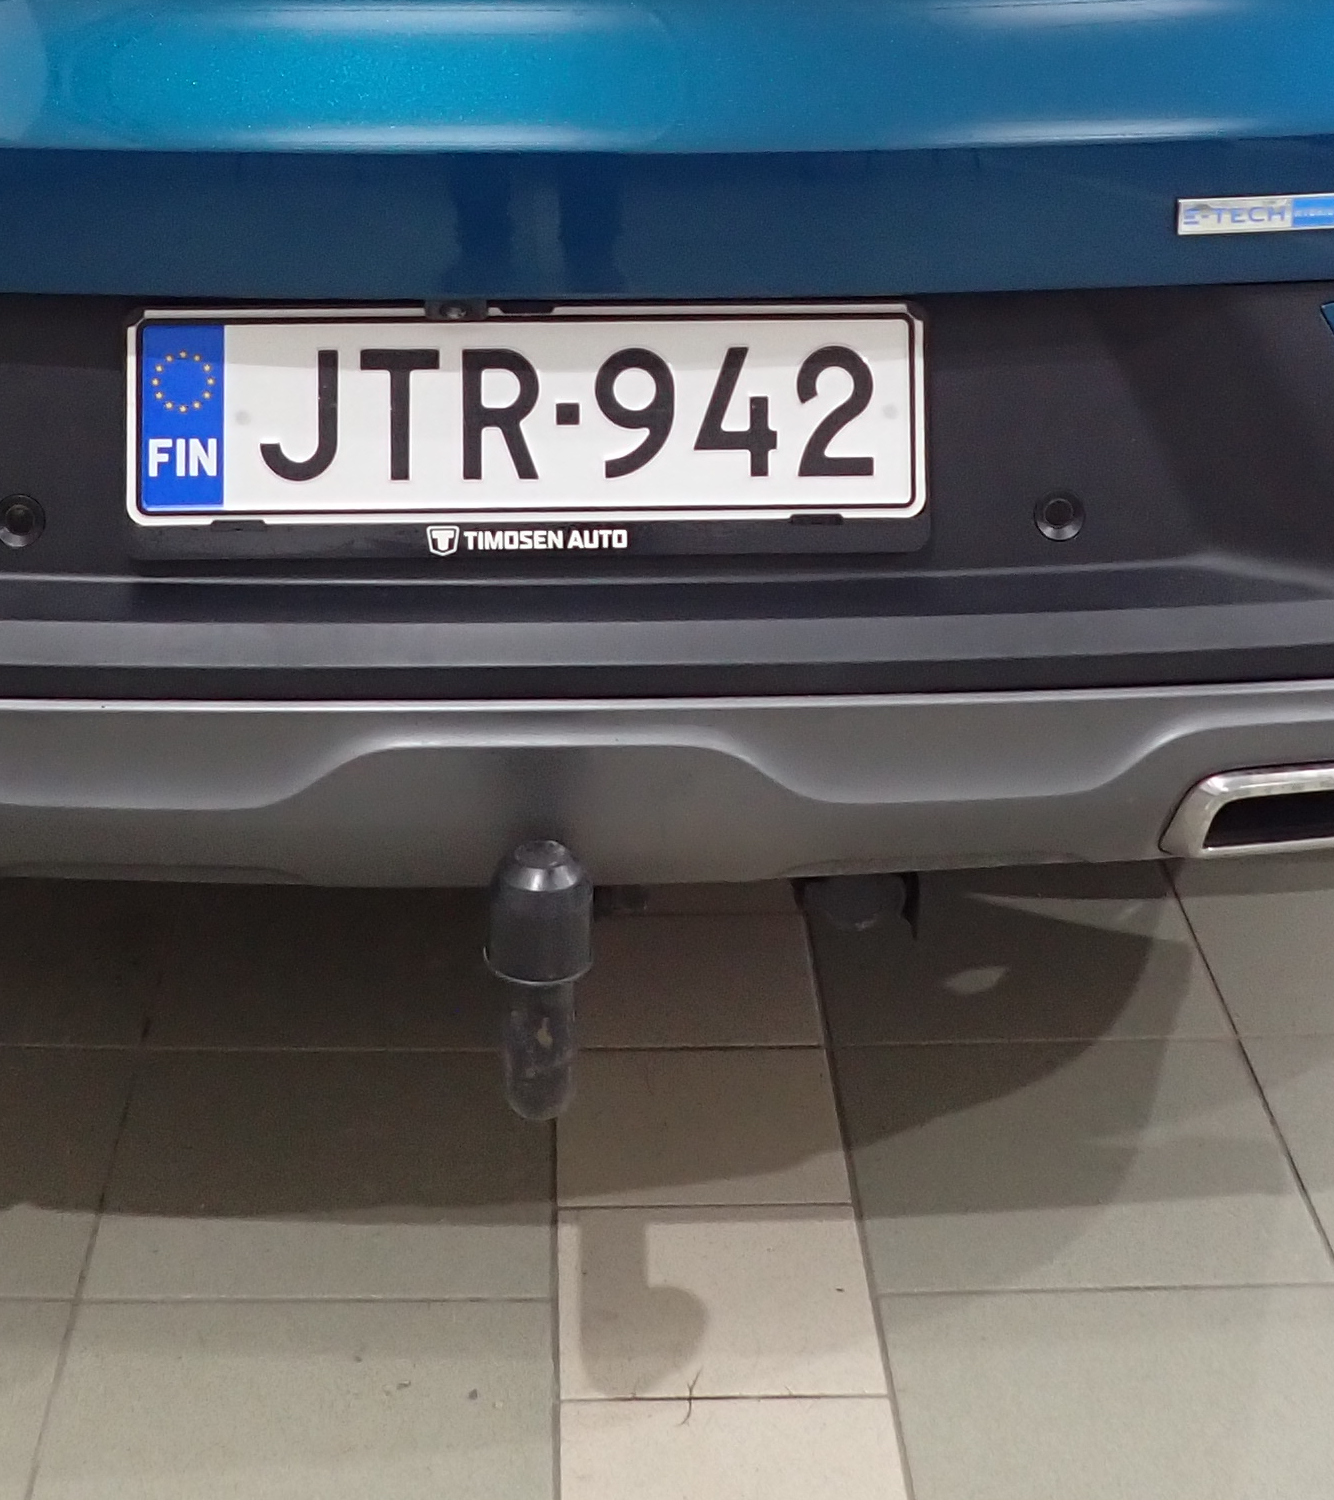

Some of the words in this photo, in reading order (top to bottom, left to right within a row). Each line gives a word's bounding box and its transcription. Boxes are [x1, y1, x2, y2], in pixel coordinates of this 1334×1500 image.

[1183, 205, 1286, 225] E-TECH
[259, 345, 875, 482] JTR-942
[148, 437, 217, 479] FIN
[463, 530, 564, 550] TIMOSEN
[567, 529, 628, 549] AUTO
